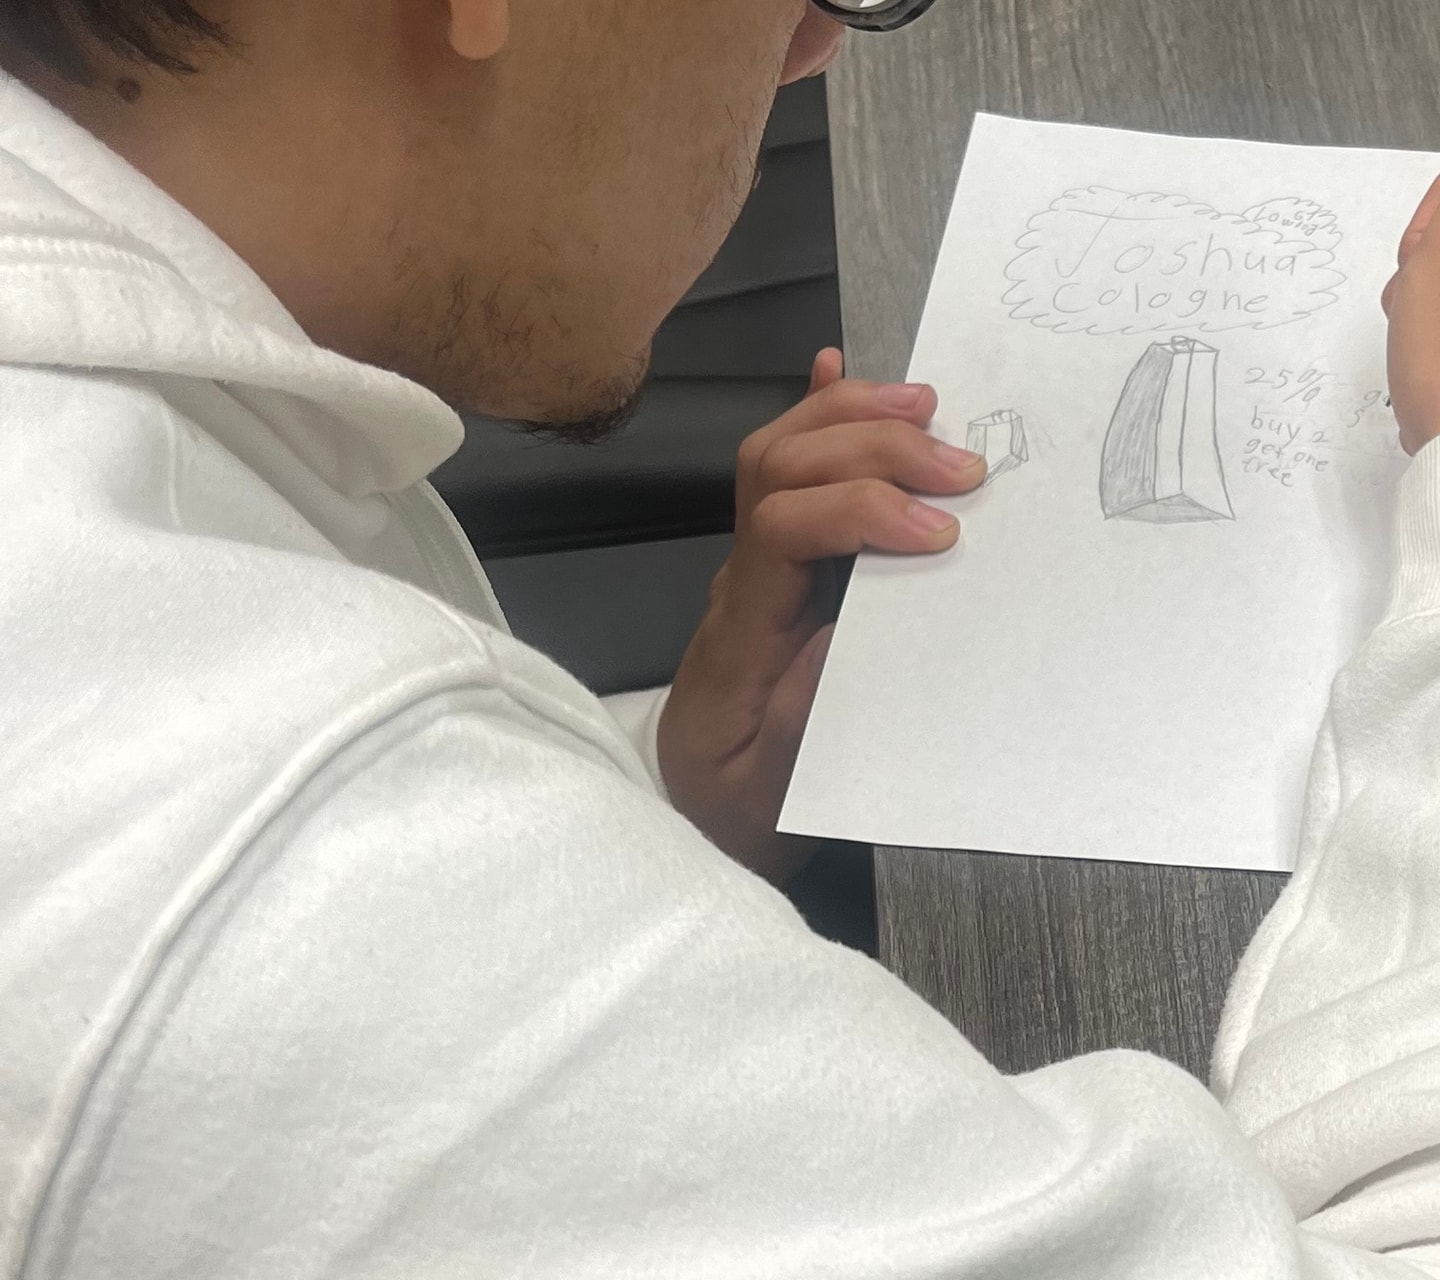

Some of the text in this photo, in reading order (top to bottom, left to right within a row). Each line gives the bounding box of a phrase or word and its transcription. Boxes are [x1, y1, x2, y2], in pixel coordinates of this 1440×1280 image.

[1054, 206, 1298, 278] Joshua
[1052, 281, 1269, 318] Cologne
[1250, 405, 1301, 445] buy
[1245, 438, 1329, 473] get one
